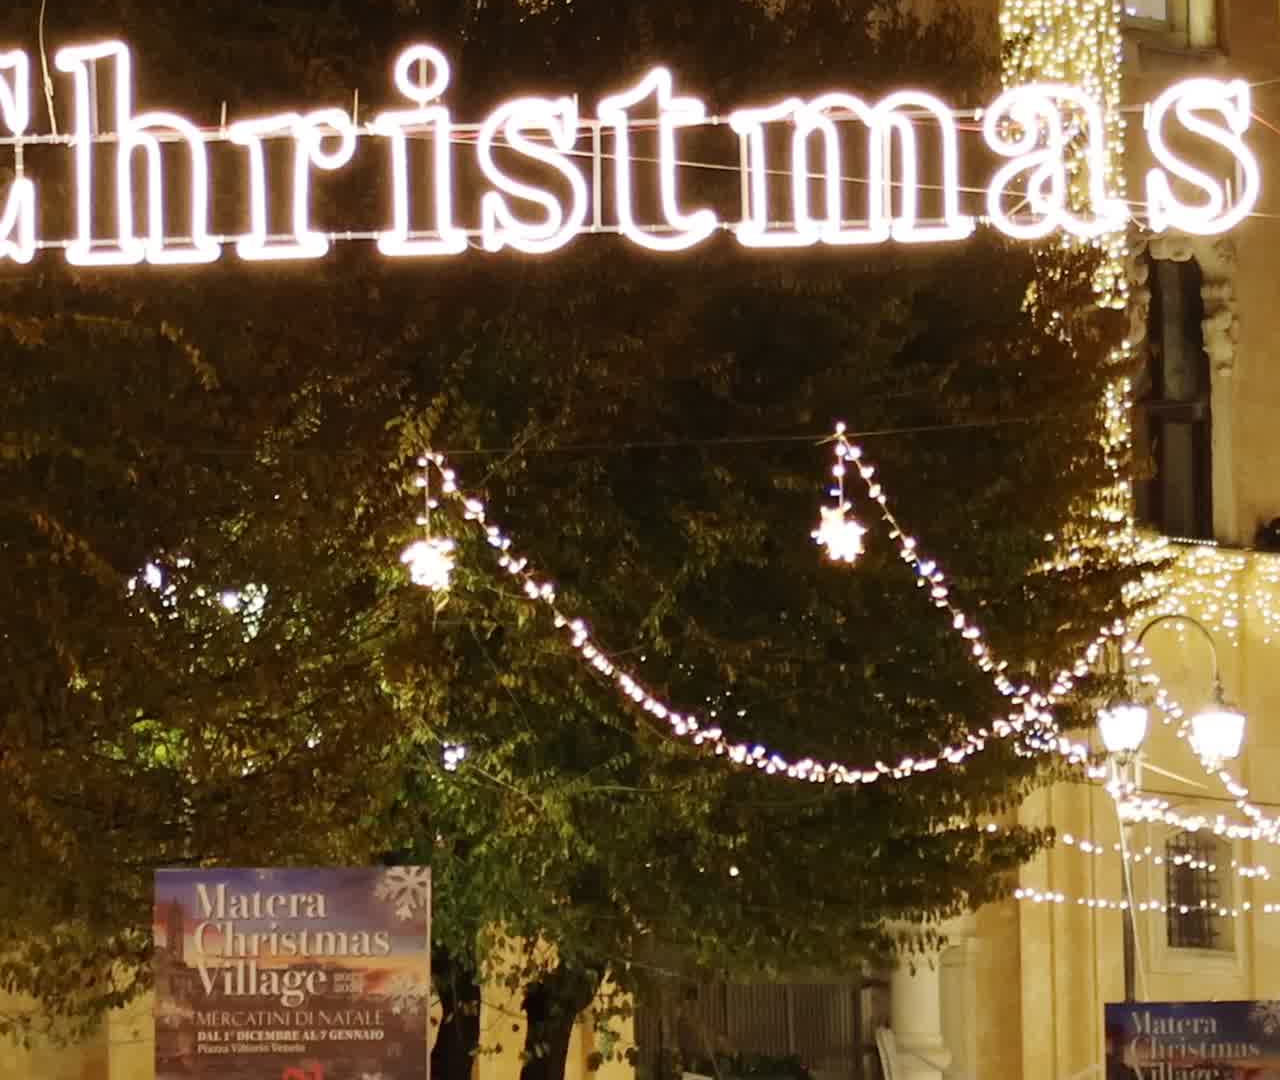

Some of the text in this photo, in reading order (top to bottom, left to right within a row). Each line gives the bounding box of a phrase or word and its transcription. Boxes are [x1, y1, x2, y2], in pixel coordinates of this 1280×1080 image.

[192, 883, 327, 920] Matera
[192, 921, 391, 958] Christmas
[195, 960, 328, 1007] Village
[195, 1009, 384, 1026] MERCATINI DI NATALE
[1131, 1010, 1217, 1035] Matera
[197, 1030, 221, 1041] DAL
[236, 1030, 300, 1041] DICEMBRE
[303, 1030, 319, 1041] AL
[329, 1029, 384, 1041] GENNAIO
[1129, 1035, 1261, 1059] Christmas
